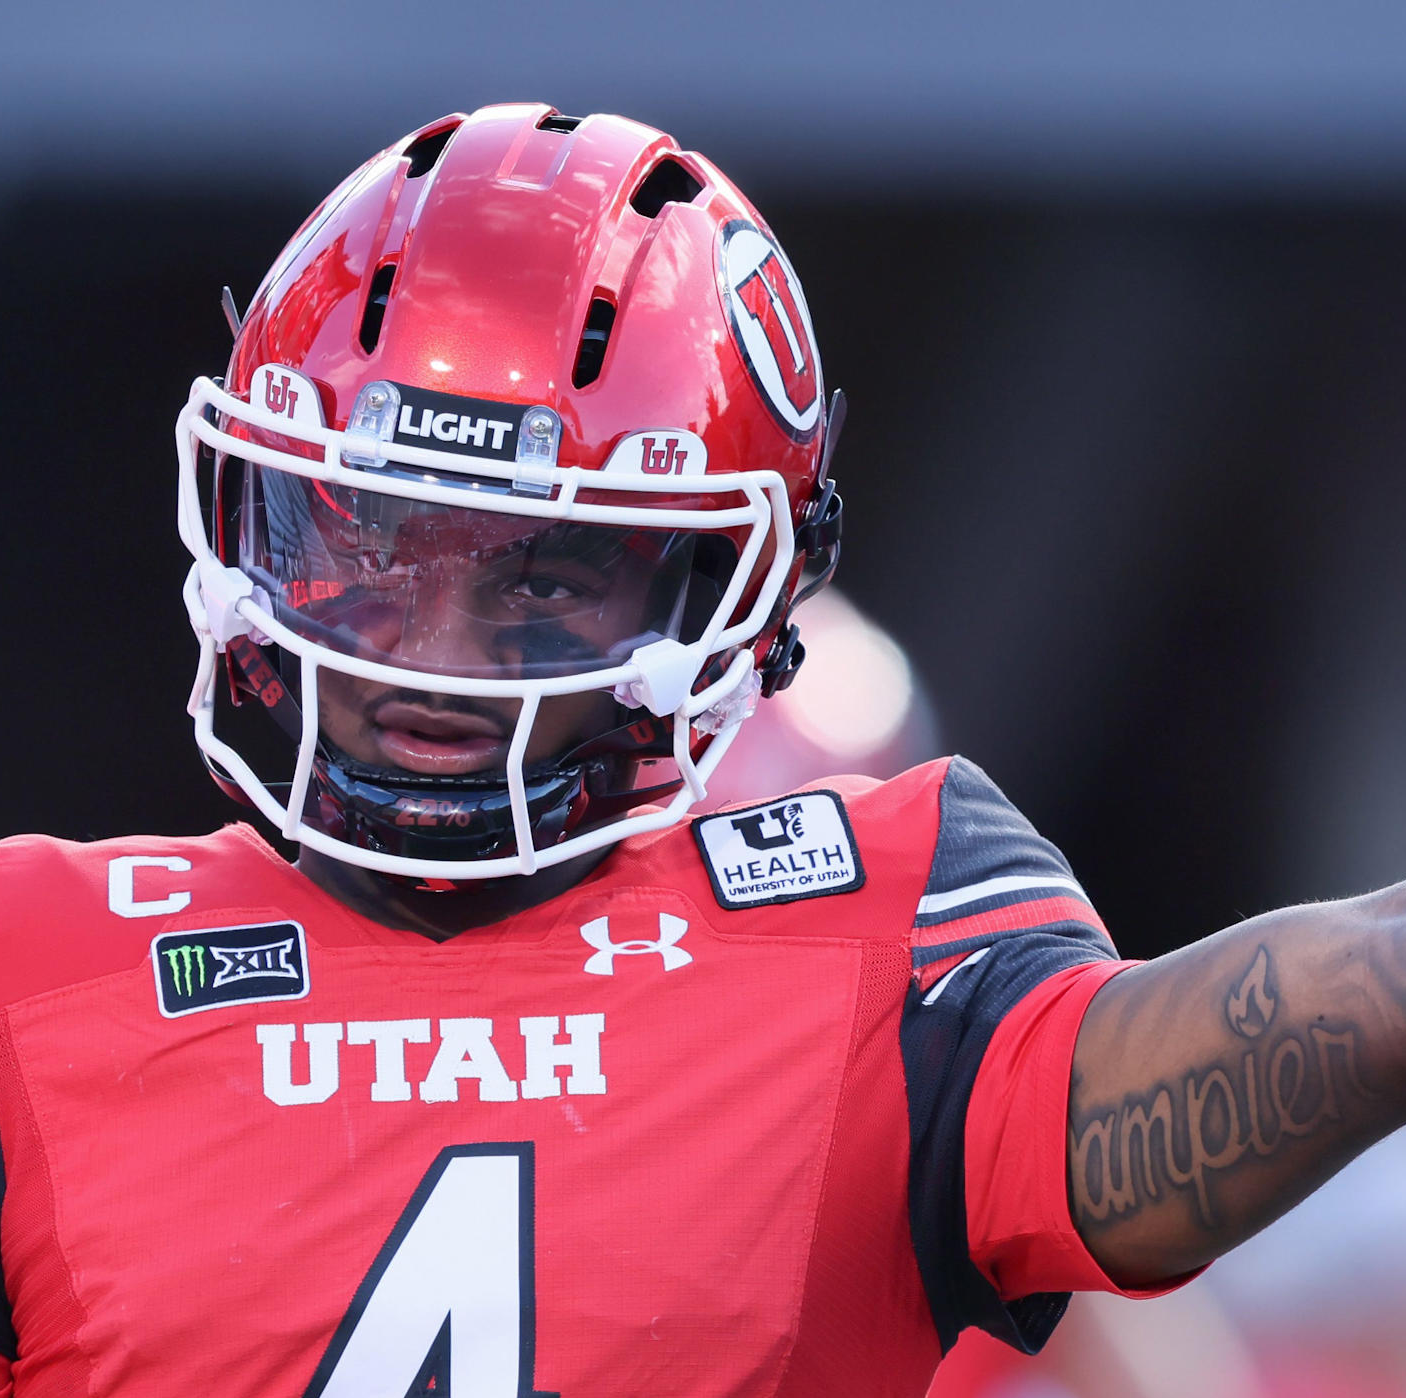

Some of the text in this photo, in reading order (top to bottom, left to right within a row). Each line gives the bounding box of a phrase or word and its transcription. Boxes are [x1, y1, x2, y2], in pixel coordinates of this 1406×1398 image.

[735, 249, 817, 416] U
[397, 405, 514, 450] LIGHT
[395, 798, 471, 827] 22%
[108, 856, 191, 919] C
[724, 844, 845, 884] HEALTH
[728, 869, 849, 896] UNIVERSITY OF UTAH
[255, 1013, 608, 1106] UTAH
[1069, 1025, 1380, 1227] ampier
